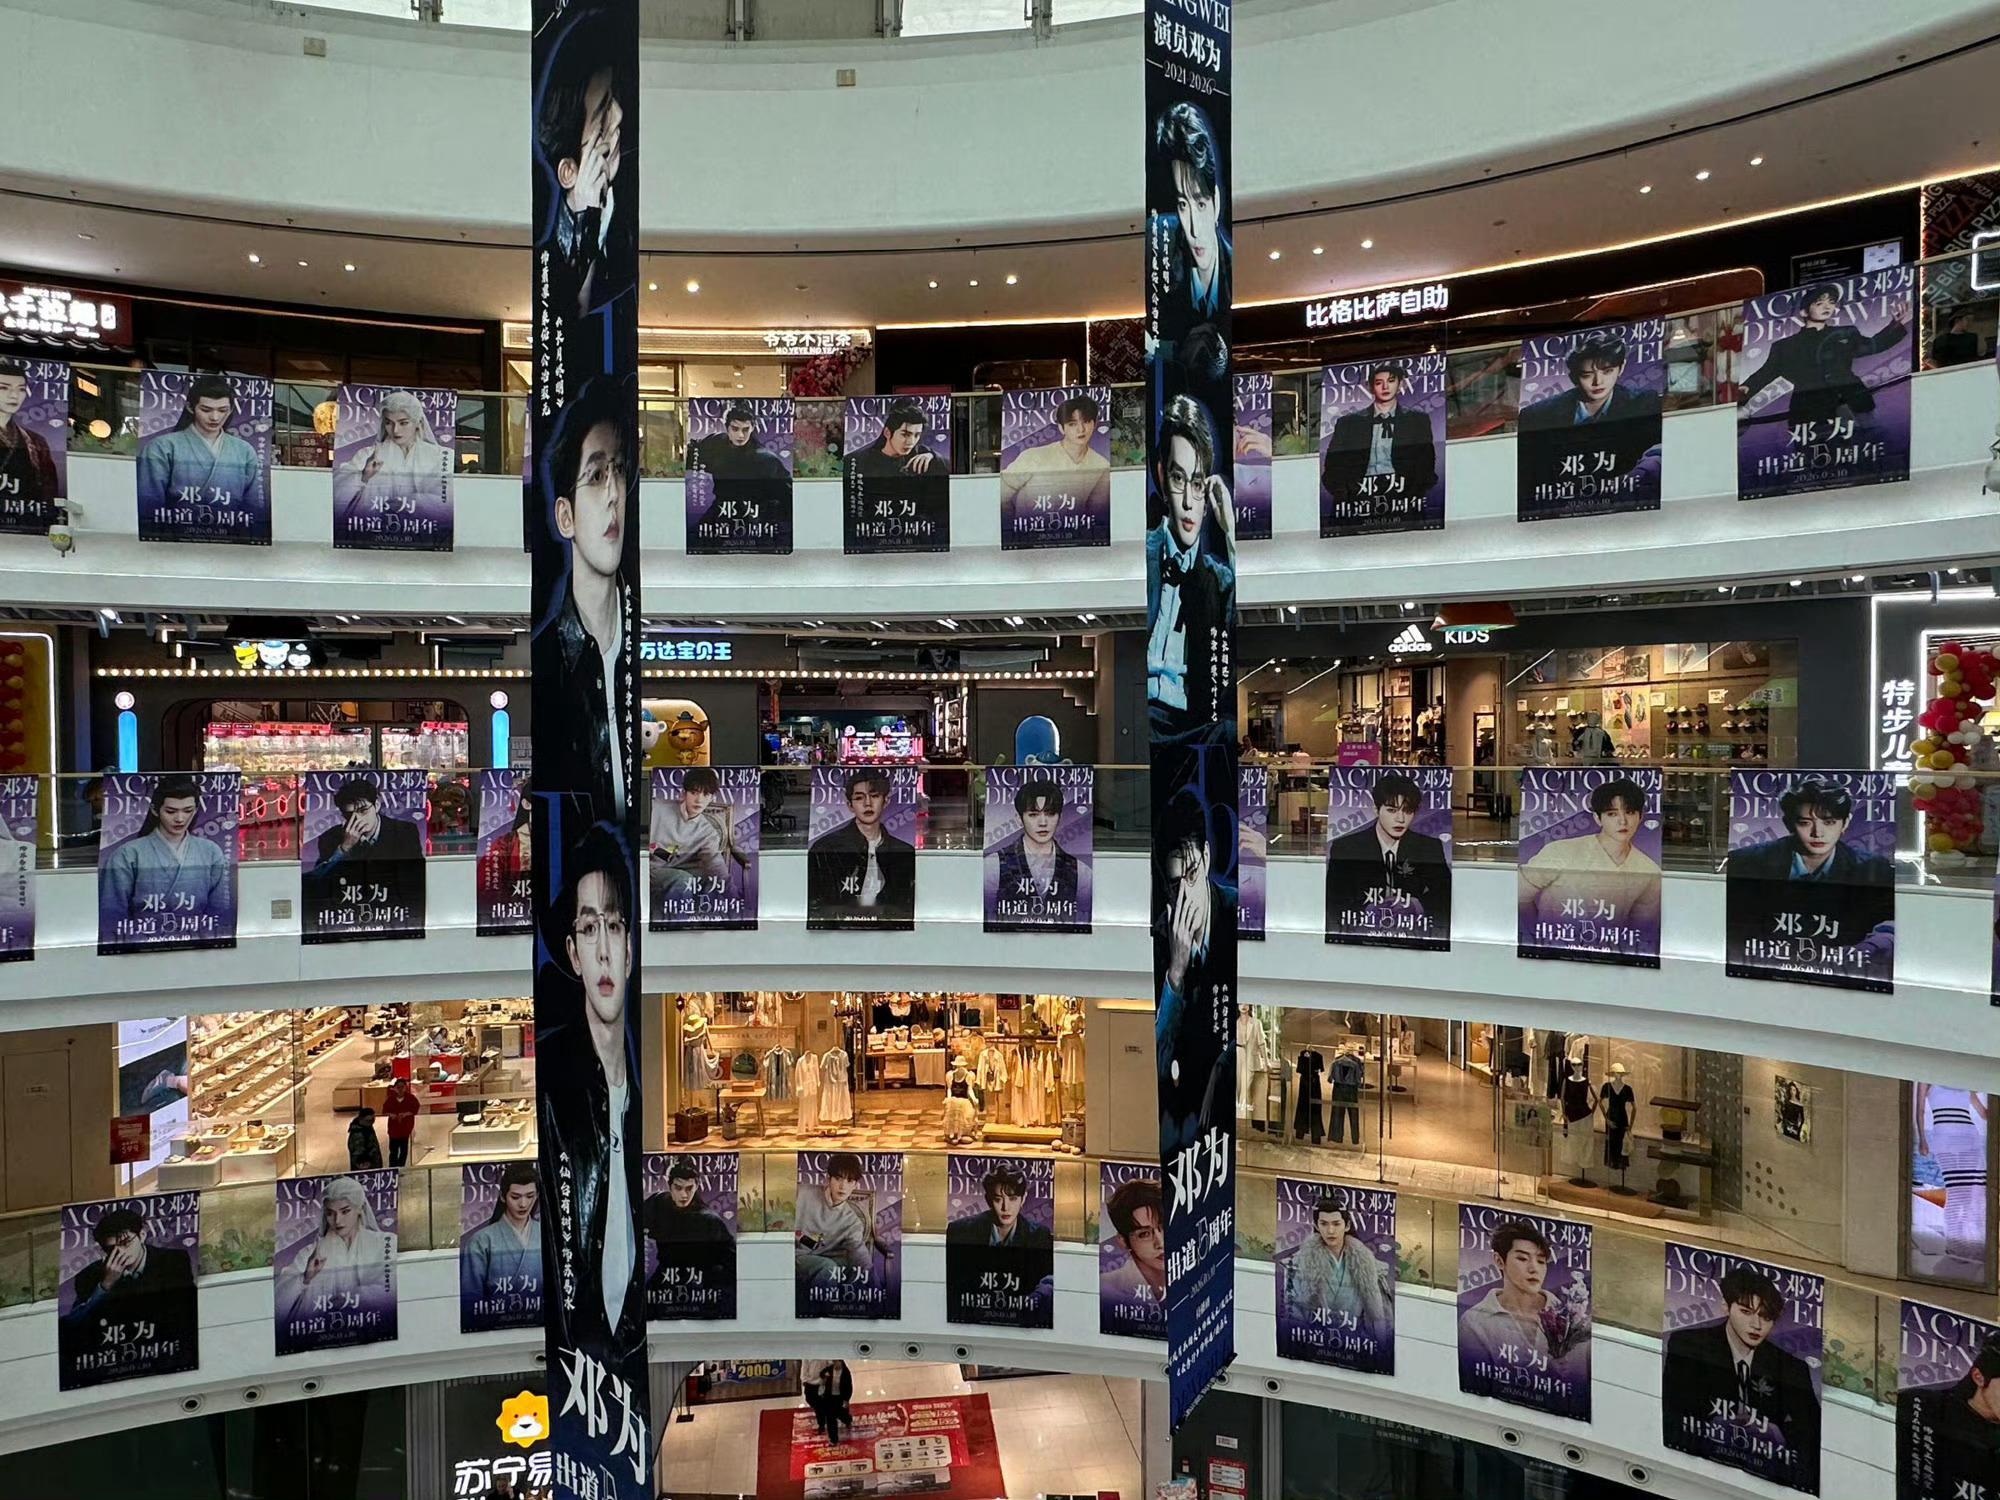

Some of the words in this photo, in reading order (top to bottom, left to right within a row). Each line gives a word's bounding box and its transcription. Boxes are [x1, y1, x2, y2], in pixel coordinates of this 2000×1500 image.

[1153, 11, 1221, 72] 演员邓为
[1164, 61, 1187, 85] 2021
[1189, 71, 1216, 95] 2026
[1943, 229, 1975, 253] BIG
[1873, 267, 1915, 294] 邓为
[1936, 261, 1966, 287] BIG
[1305, 283, 1449, 328] 比格比萨自助
[763, 331, 852, 348] 爷爷不泡茶
[1630, 319, 1666, 342] 邓为
[36, 363, 70, 381] 邓为
[1416, 353, 1447, 375] 邓为
[244, 380, 274, 398] 邓为
[1246, 374, 1273, 392] 邓为
[428, 389, 457, 409] 邓为
[926, 395, 951, 412] 邓为
[1086, 386, 1111, 403] 邓为
[770, 399, 795, 415] 邓为
[1786, 417, 1855, 447] 邓为
[1559, 450, 1615, 476] 邓为
[1757, 442, 1884, 476] 出道5周年
[1356, 473, 1405, 495] 邓为
[1535, 474, 1640, 501] 出道5周年
[179, 486, 231, 505] 邓为
[371, 495, 416, 513] 邓为
[1033, 493, 1075, 511] 邓为
[154, 504, 254, 527] 出道5周年
[718, 500, 759, 518] 邓为
[874, 499, 916, 517] 邓为
[1335, 495, 1426, 518] 出道5周年
[348, 514, 438, 534] 出道5周年
[699, 518, 779, 538] 出道5周年
[856, 517, 935, 537] 出道5周年
[1013, 511, 1095, 533] 出道5周年
[640, 641, 732, 660] 万达宝贝王
[1388, 642, 1432, 653] adidas
[1445, 630, 1490, 644] KIDS
[3, 777, 38, 796] 邓为
[210, 774, 241, 792] 邓为
[400, 771, 428, 789] 邓为
[736, 768, 761, 785] 邓为
[893, 767, 918, 785] 邓为
[985, 768, 1068, 786] ACTOR
[1068, 767, 1094, 785] 邓为
[1240, 768, 1268, 786] 邓为
[1424, 769, 1453, 788] 邓为
[1631, 769, 1662, 789] 邓为
[1856, 772, 1897, 797] 邓为
[1329, 810, 1368, 836] 2021
[340, 884, 388, 904] 邓为
[511, 880, 532, 898] 邓
[684, 875, 725, 894] 邓为
[1016, 877, 1058, 896] 邓为
[143, 892, 195, 913] 邓为
[663, 894, 745, 914] 出道5周年
[998, 895, 1077, 915] 出道5周年
[1363, 887, 1411, 908] 邓为
[319, 904, 409, 925] 出道5周年
[1341, 907, 1433, 931] 出道5周年
[1560, 898, 1616, 921] 邓为
[117, 913, 219, 936] 出道5周年
[1536, 920, 1640, 946] 出道5周年
[1773, 912, 1839, 939] 邓为
[1744, 936, 1870, 967] 出道5周年
[714, 1154, 738, 1172] 邓为
[878, 1154, 903, 1172] 邓为
[1030, 1160, 1054, 1178] 邓为
[371, 1171, 398, 1190] 邓为
[1168, 1125, 1230, 1226] 邓为
[169, 1193, 200, 1214] 邓为
[1369, 1193, 1397, 1213] 邓为
[1167, 1206, 1232, 1287] 出道5周年
[1560, 1225, 1592, 1249] 邓为
[495, 1275, 537, 1294] 邓为
[662, 1267, 703, 1284] 邓为
[828, 1265, 869, 1284] 邓为
[980, 1272, 1020, 1291] 邓为
[1459, 1263, 1502, 1290] 2021
[809, 1283, 886, 1302] 出道5周年
[1786, 1274, 1824, 1302] 邓为
[313, 1291, 360, 1312] 邓为
[473, 1293, 541, 1314] 出道5周
[961, 1290, 1038, 1310] 出道5周年
[290, 1310, 381, 1336] 出道5周年
[1114, 1302, 1163, 1323] 出道5
[1311, 1307, 1357, 1331] 邓为
[1664, 1302, 1713, 1328] 2021
[102, 1320, 155, 1345] 邓为
[1290, 1327, 1378, 1355] 出道5周年
[76, 1340, 180, 1371] 出道5周年
[1499, 1344, 1548, 1372] 邓为
[1475, 1361, 1571, 1397] 出道5周年
[558, 1347, 646, 1485] 邓为
[1710, 1397, 1769, 1433] 邓为
[1683, 1415, 1798, 1465] 出道5周年
